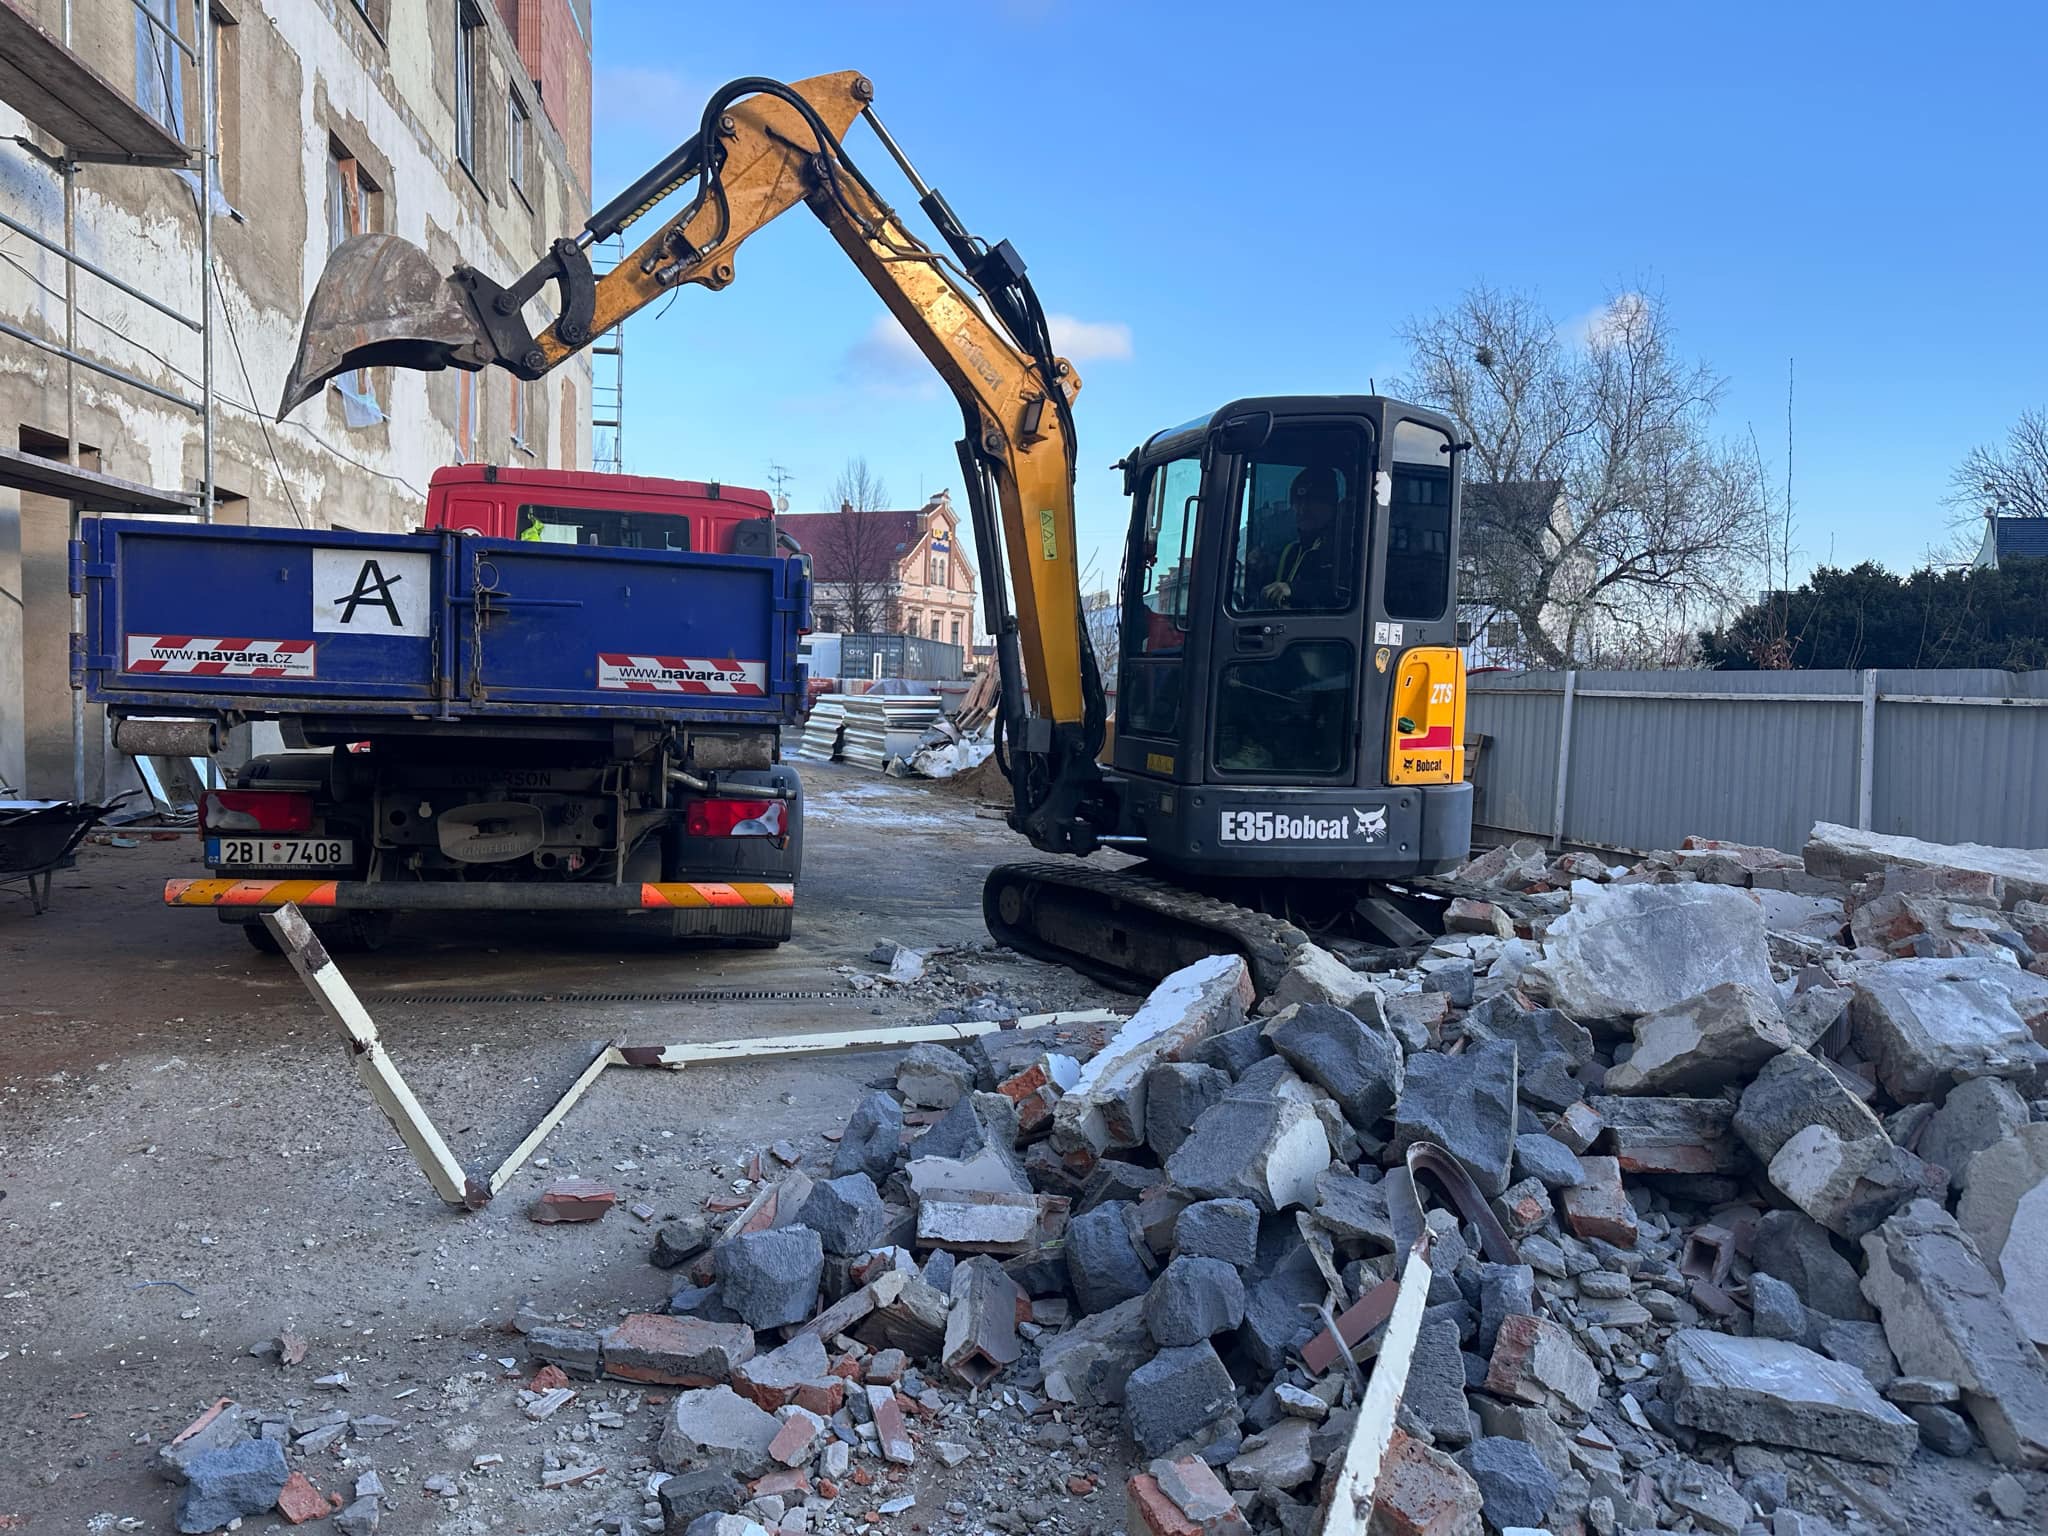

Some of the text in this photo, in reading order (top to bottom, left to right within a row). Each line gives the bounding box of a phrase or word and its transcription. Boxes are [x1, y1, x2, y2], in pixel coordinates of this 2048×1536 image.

[334, 559, 403, 627] A
[151, 648, 293, 664] www.navara.cz
[619, 667, 746, 682] www.navara.cz
[1430, 683, 1453, 705] ZTS
[1415, 759, 1442, 773] Bobcat
[1220, 811, 1350, 842] E35 Bobcat
[226, 842, 342, 863] 2BI 7408
